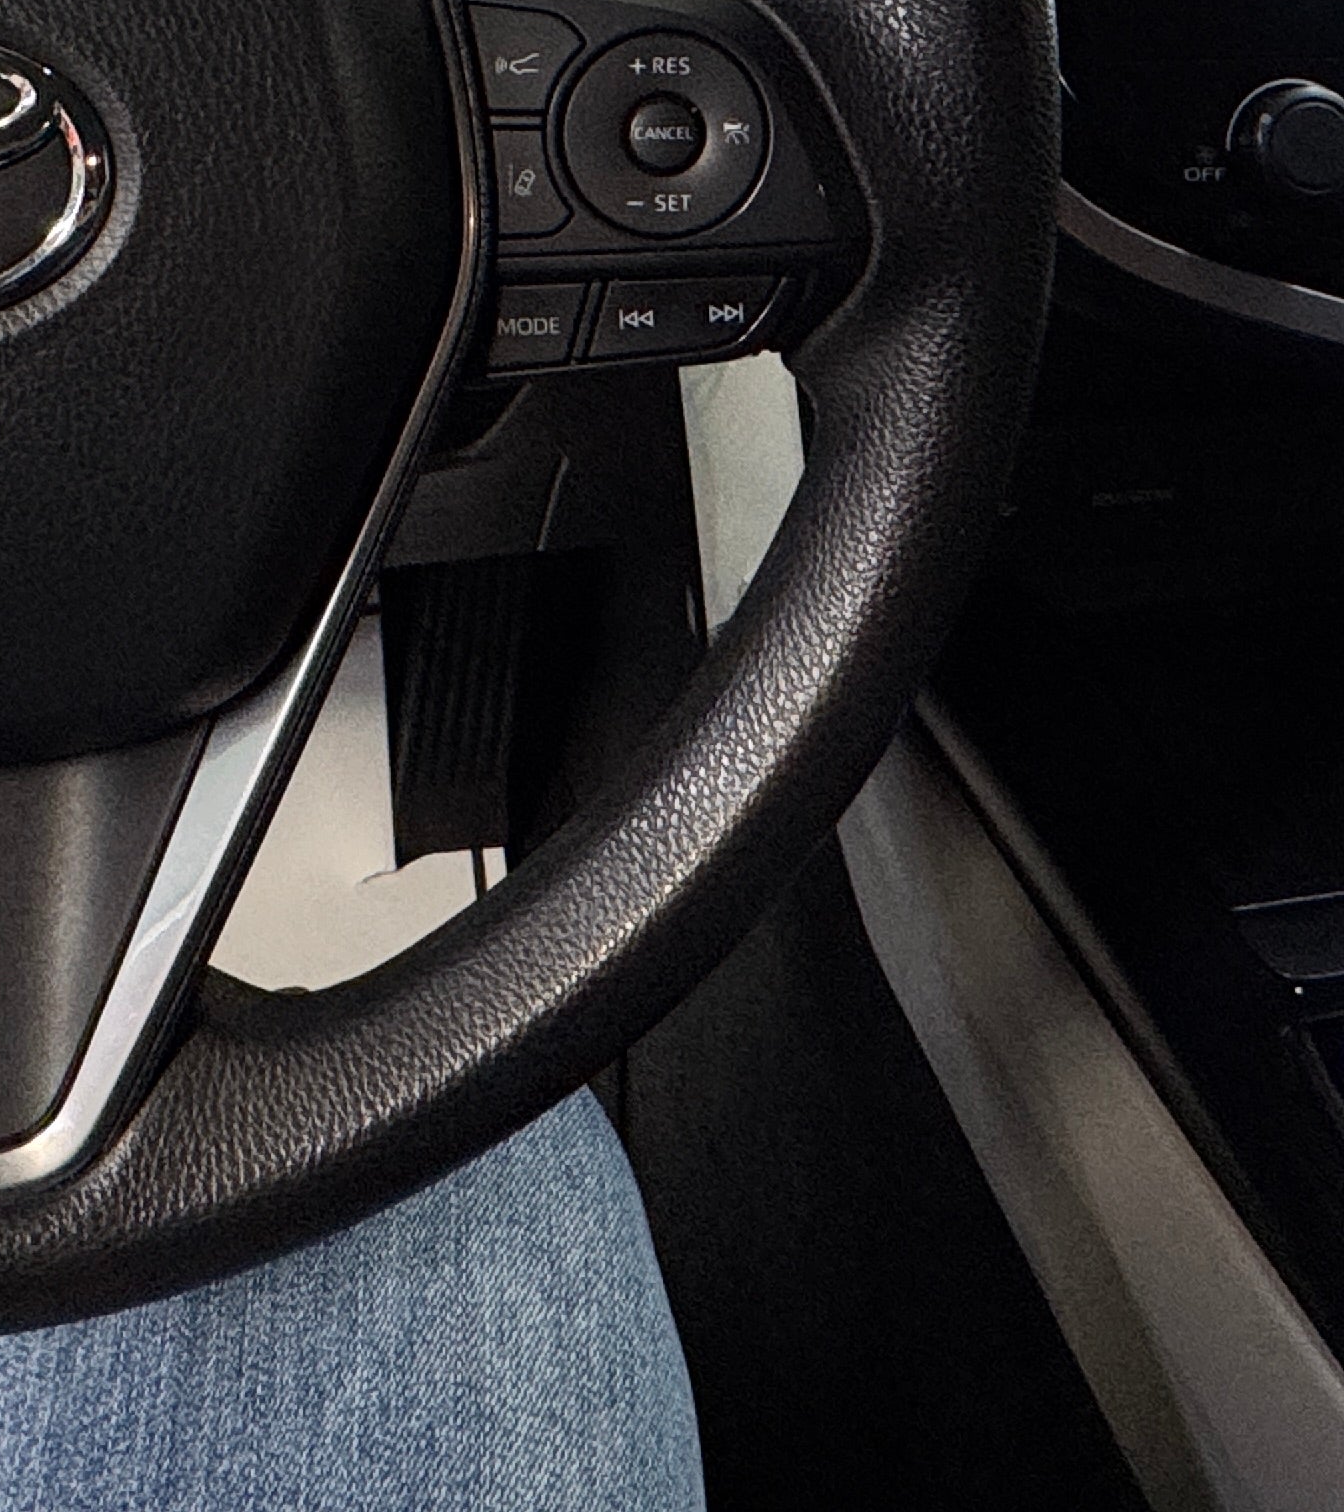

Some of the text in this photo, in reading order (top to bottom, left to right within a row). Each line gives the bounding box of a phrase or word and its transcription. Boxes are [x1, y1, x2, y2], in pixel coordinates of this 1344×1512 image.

[652, 57, 691, 76] RES
[634, 126, 694, 141] CANCEL
[1183, 166, 1228, 183] OFF
[654, 194, 692, 212] SET
[497, 316, 560, 336] MODE
